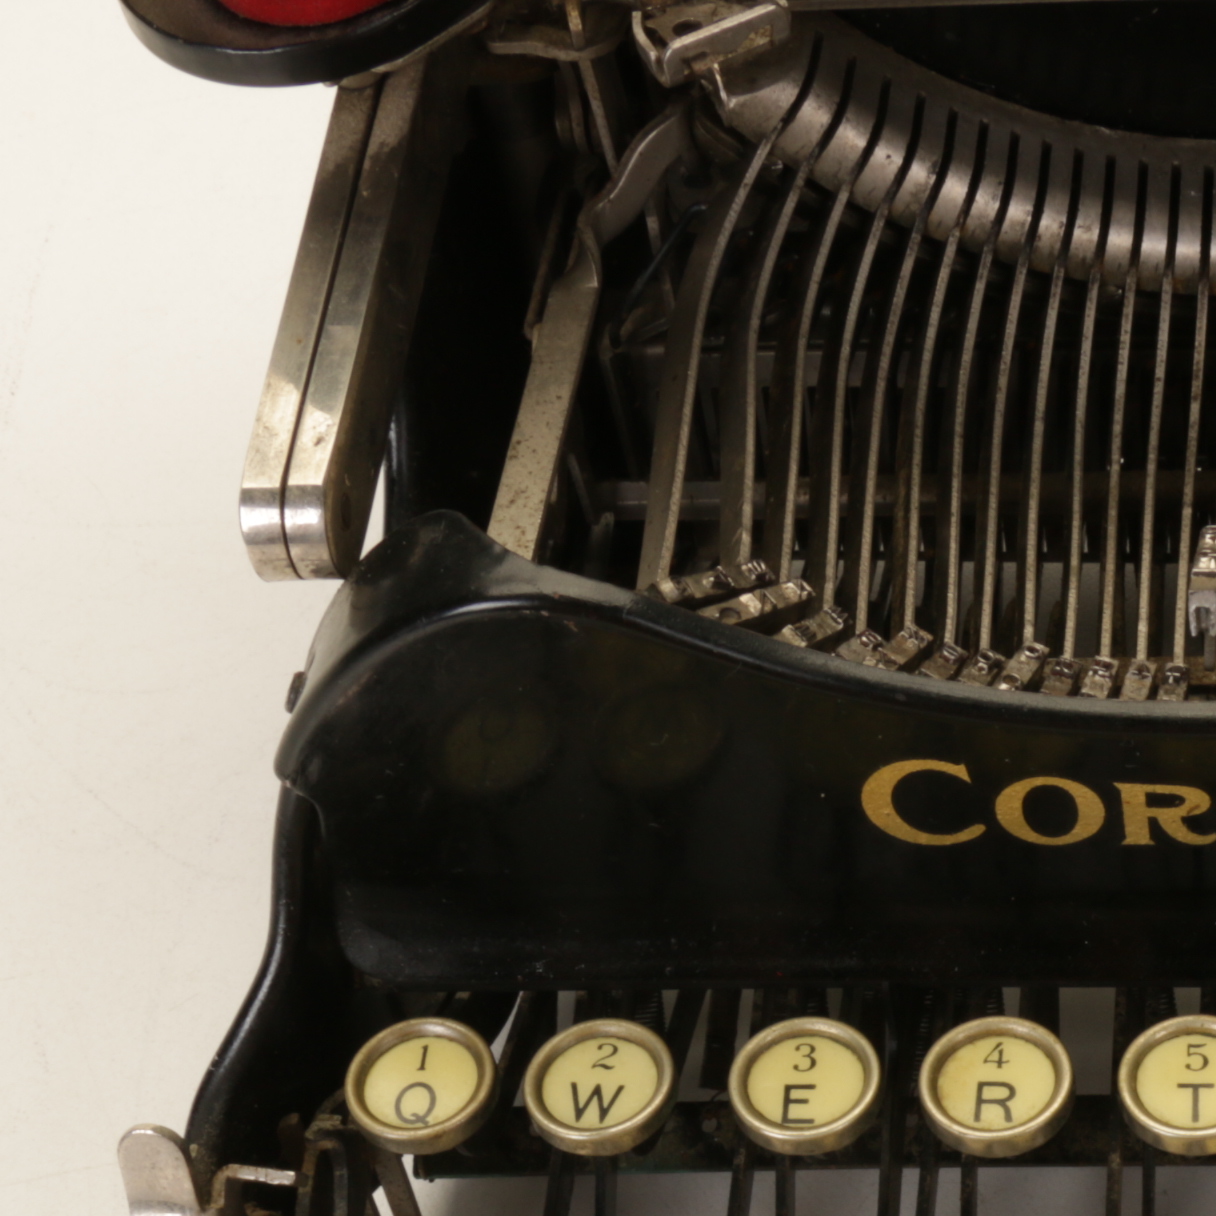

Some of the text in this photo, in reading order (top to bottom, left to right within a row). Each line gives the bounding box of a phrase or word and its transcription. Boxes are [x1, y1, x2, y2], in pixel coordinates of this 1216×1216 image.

[417, 1045, 429, 1071] 1
[592, 1043, 618, 1070] 2
[793, 1043, 816, 1072] 3
[983, 1042, 1009, 1068] 4
[1185, 1044, 1209, 1071] 5
[394, 1080, 438, 1125] Q
[570, 1081, 626, 1123] W
[780, 1083, 816, 1125] E
[974, 1081, 1016, 1122] R
[1177, 1083, 1214, 1123] T
